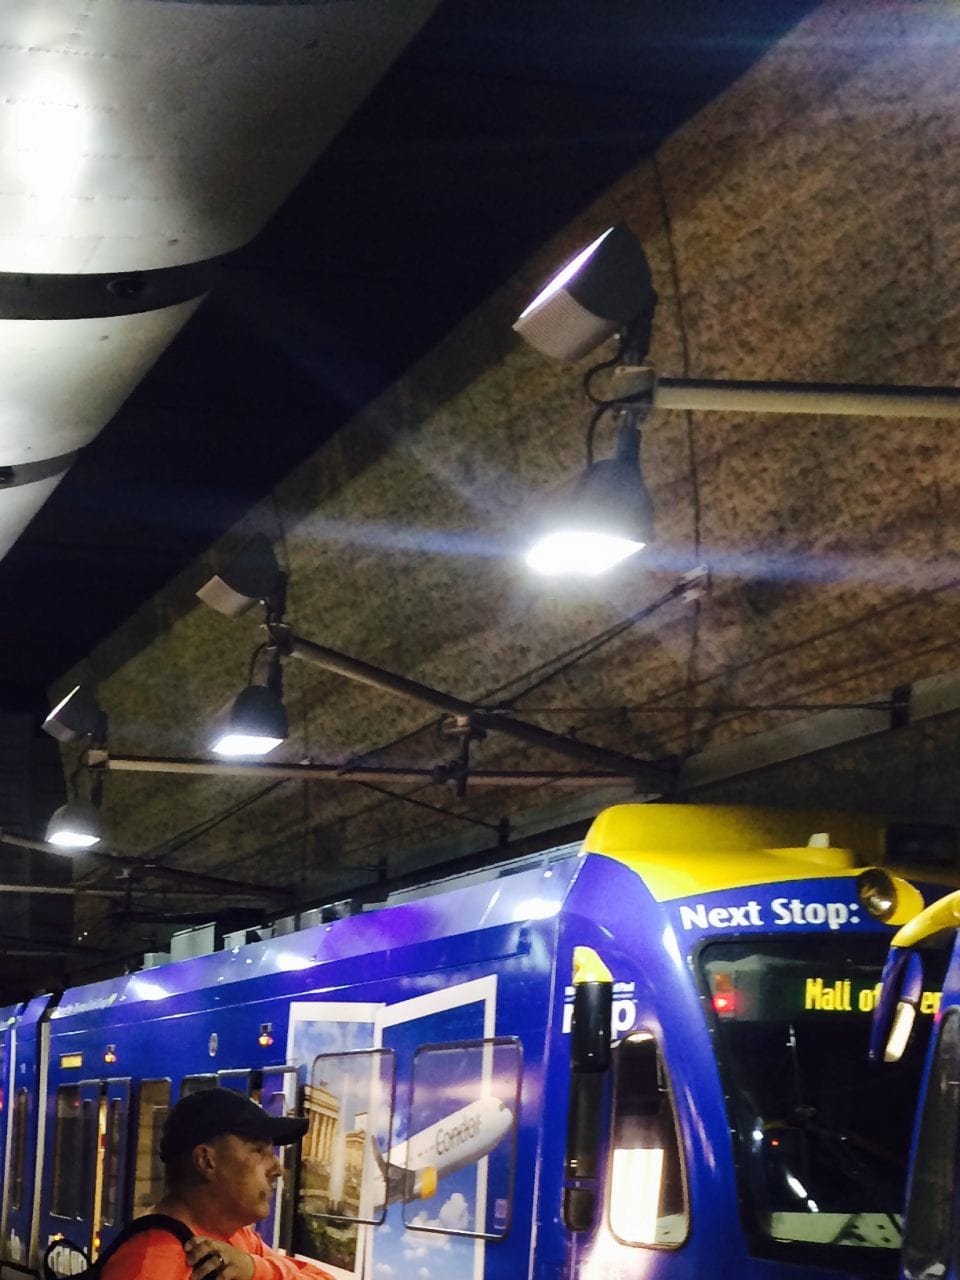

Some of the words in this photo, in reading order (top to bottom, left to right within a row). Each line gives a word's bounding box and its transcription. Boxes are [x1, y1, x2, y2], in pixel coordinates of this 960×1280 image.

[679, 901, 765, 930] Next
[771, 898, 861, 930] Stop:
[805, 977, 852, 1011] Mall
